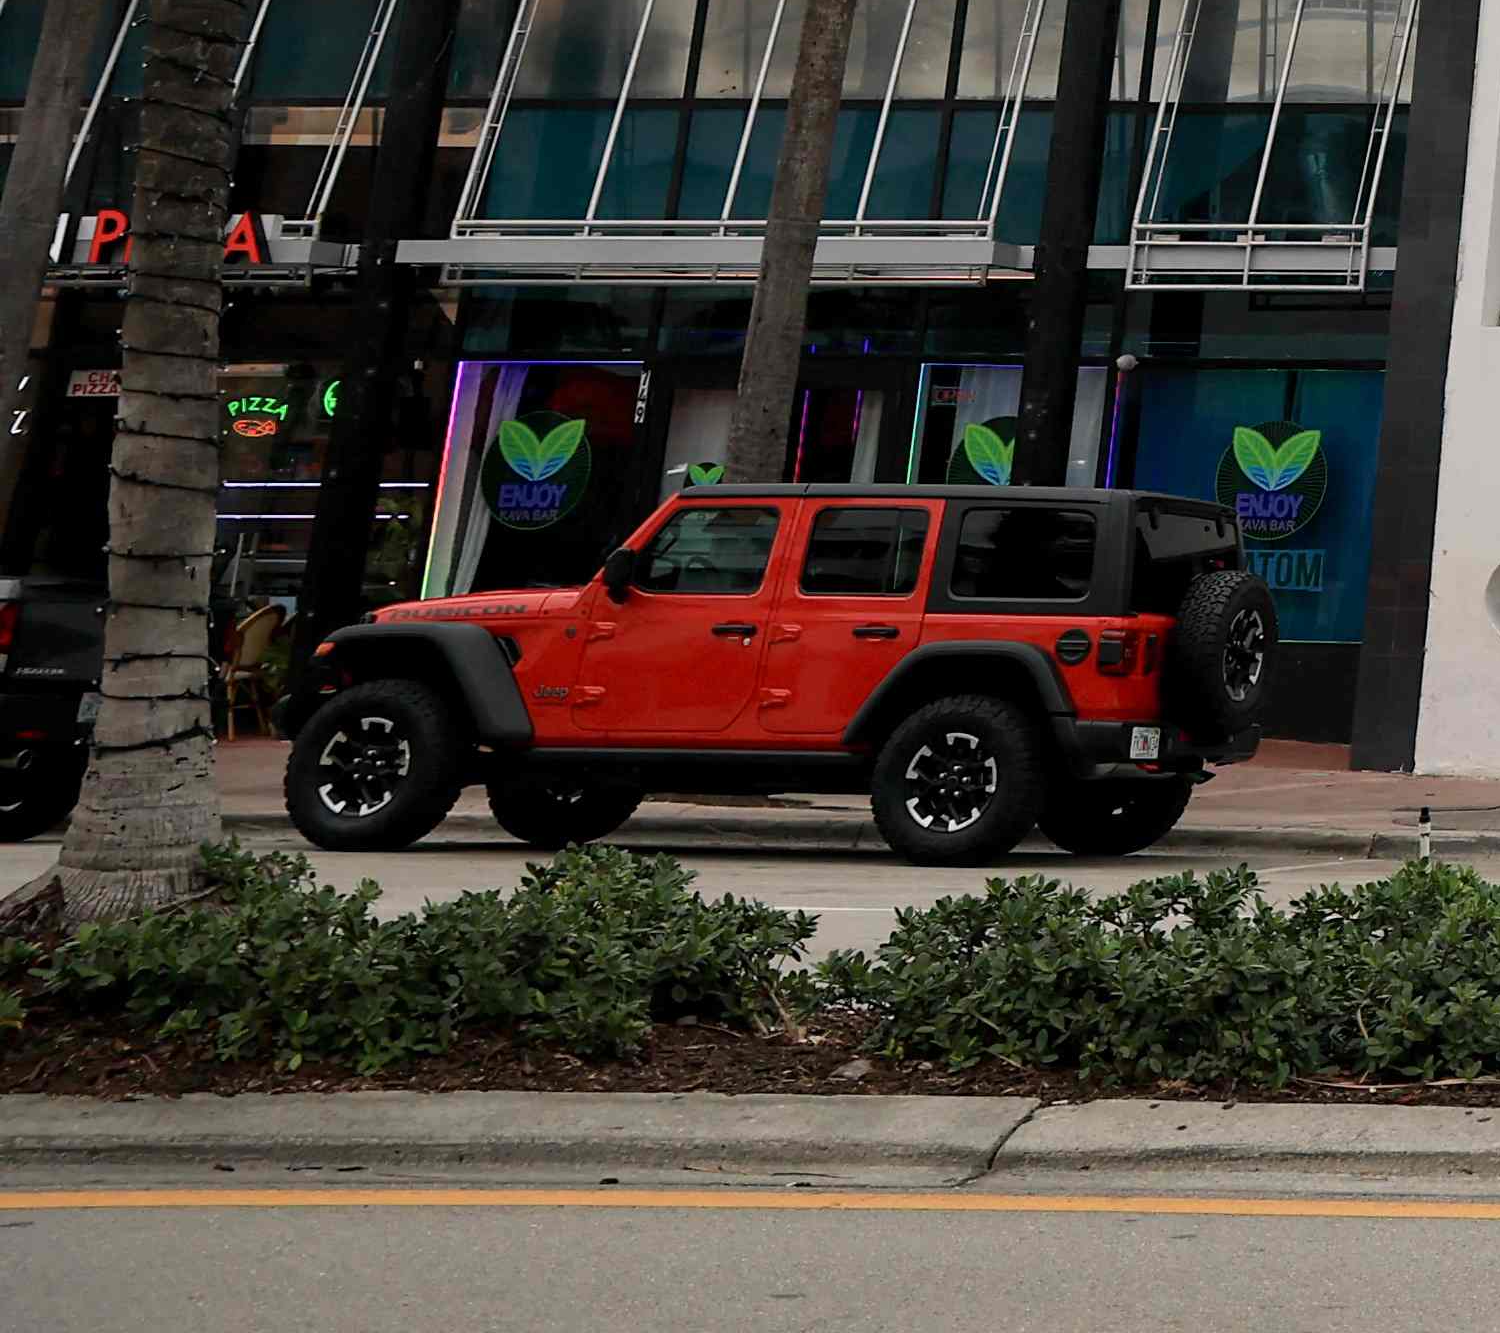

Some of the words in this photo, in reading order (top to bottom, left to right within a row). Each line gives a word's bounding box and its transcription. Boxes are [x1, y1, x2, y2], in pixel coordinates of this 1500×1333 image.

[227, 397, 289, 421] PIZZA
[498, 484, 568, 508] ENJOY
[1235, 493, 1304, 518] ENJOY
[1270, 520, 1296, 532] BAR
[533, 684, 569, 701] Jeep
